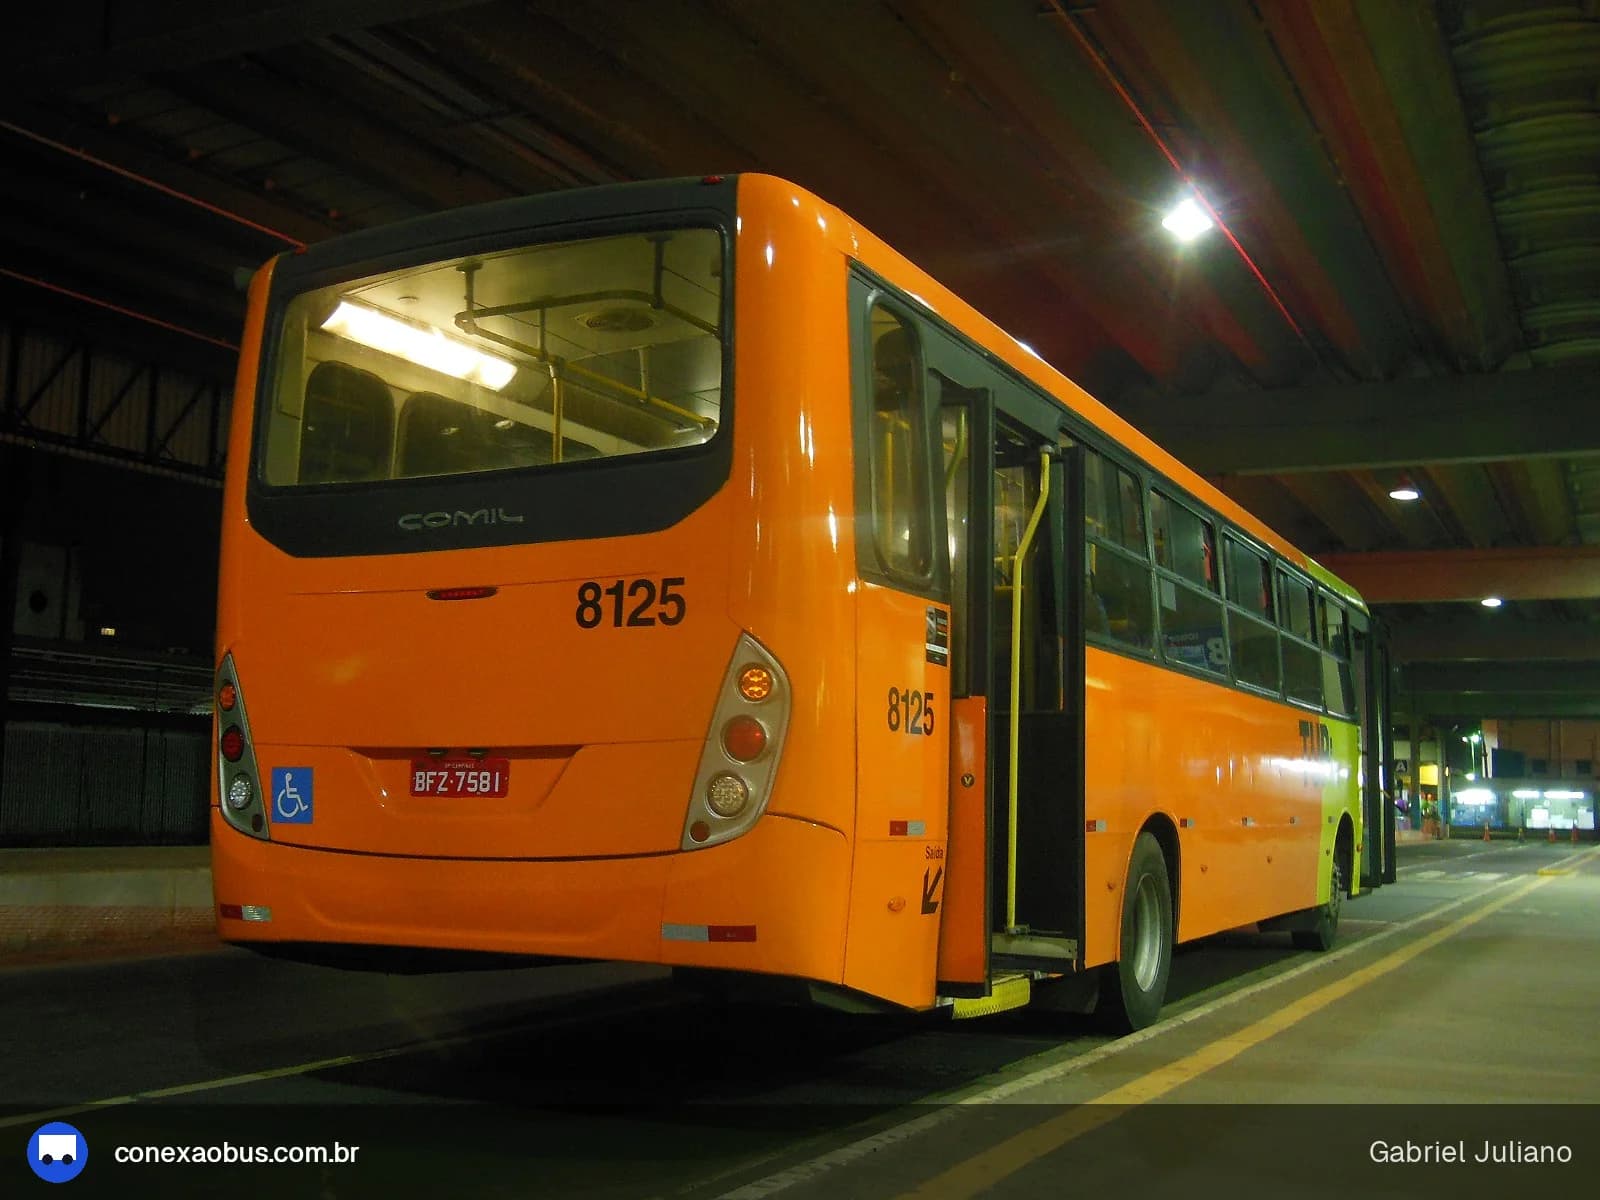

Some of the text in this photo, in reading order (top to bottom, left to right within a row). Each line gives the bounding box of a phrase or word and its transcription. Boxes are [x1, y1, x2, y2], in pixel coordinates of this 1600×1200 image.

[398, 507, 524, 531] COMIL
[576, 577, 686, 629] 8125
[888, 686, 934, 736] 8125
